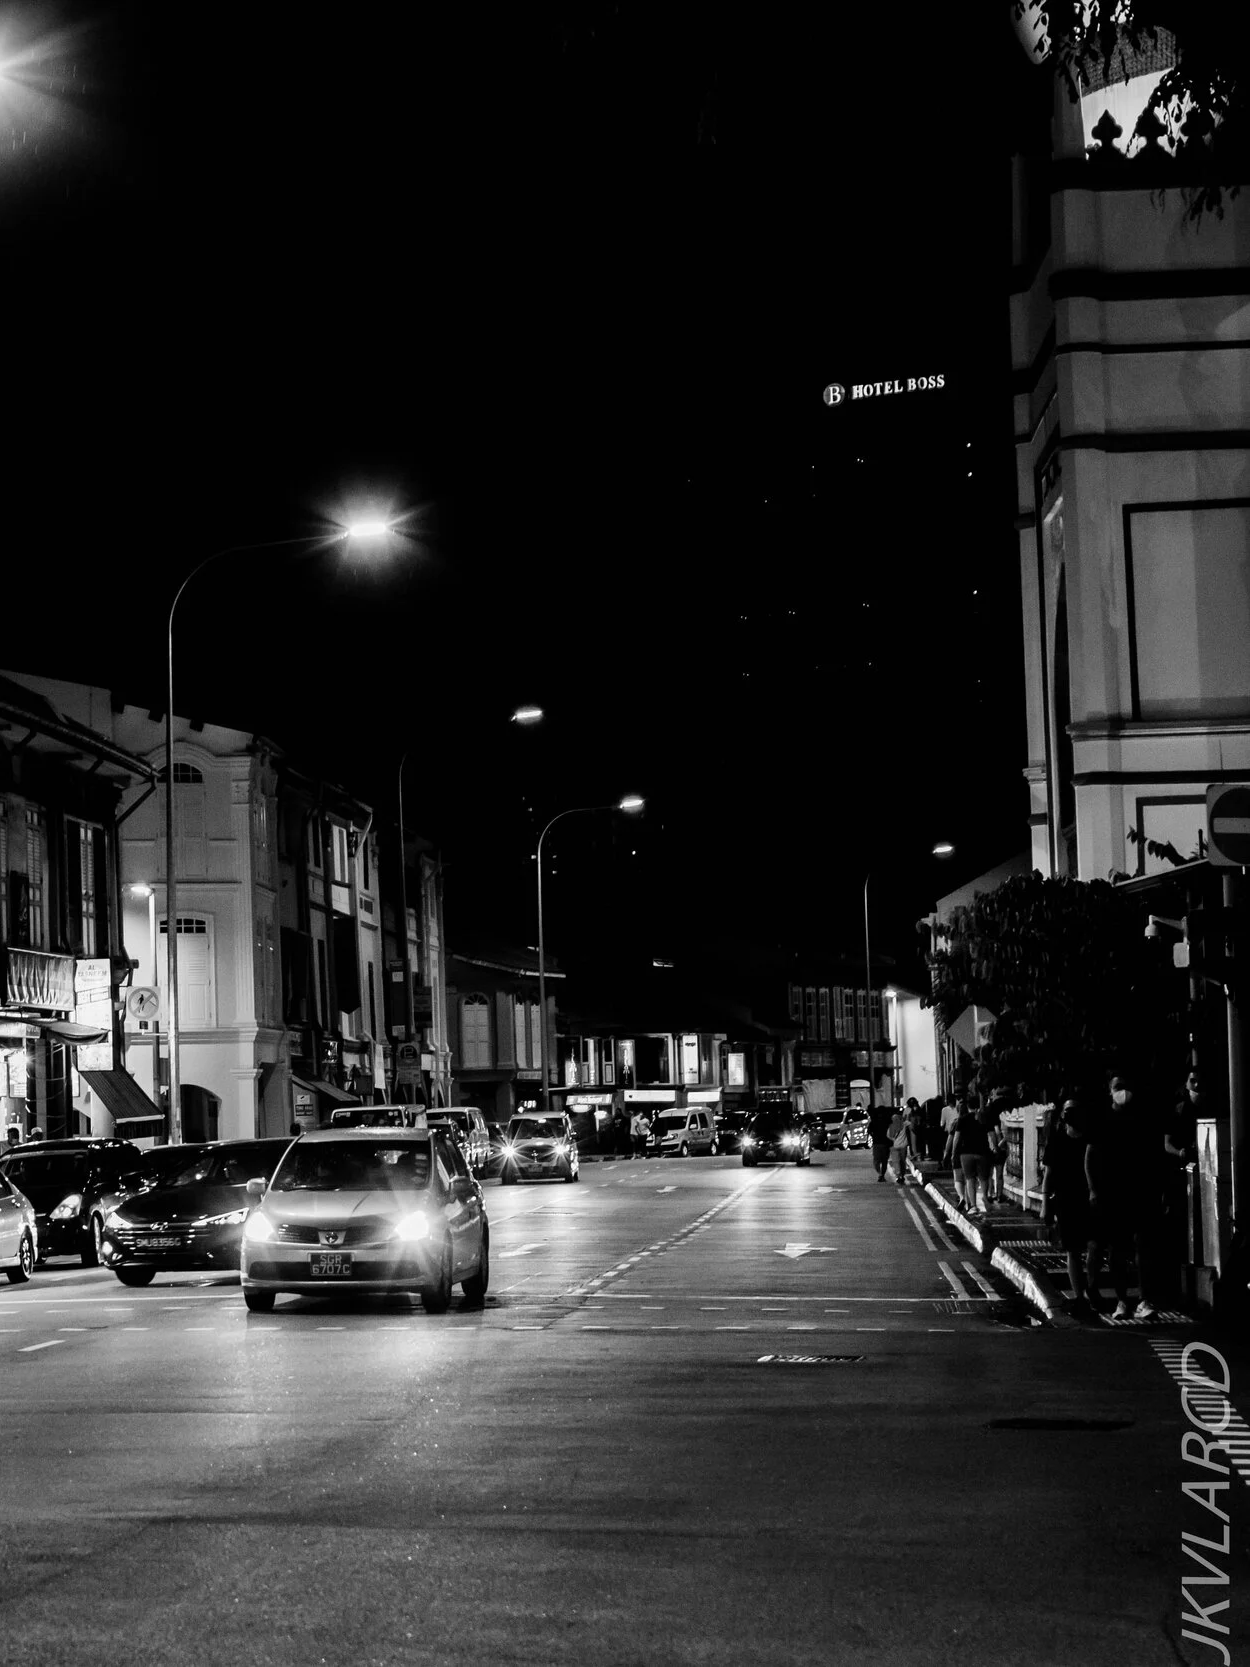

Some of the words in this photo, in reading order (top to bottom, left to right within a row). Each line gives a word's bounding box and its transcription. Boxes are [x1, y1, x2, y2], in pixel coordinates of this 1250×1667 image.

[851, 380, 904, 400] HOTEL
[907, 374, 945, 392] BOSS
[320, 1254, 343, 1264] SGR
[312, 1264, 350, 1274] 6707C
